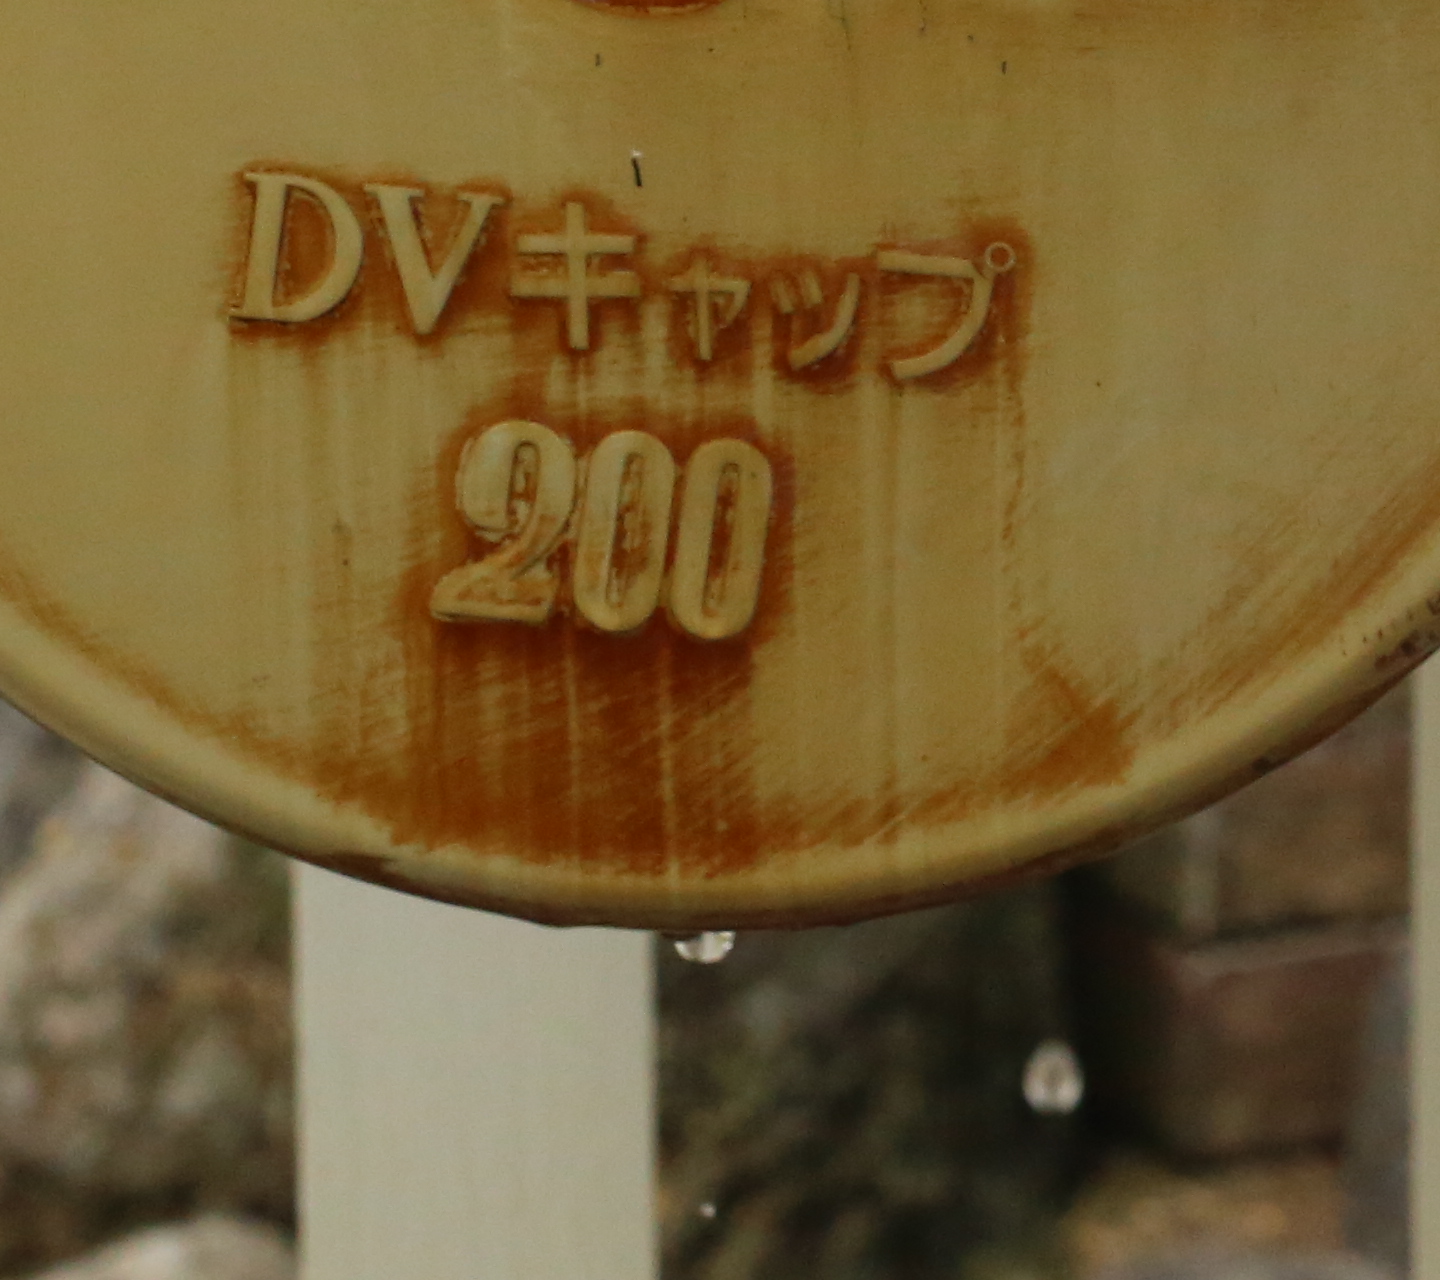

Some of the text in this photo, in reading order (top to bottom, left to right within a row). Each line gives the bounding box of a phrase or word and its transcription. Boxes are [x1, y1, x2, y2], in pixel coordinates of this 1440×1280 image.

[228, 170, 1018, 381] DVキャップ
[428, 418, 774, 640] 200
